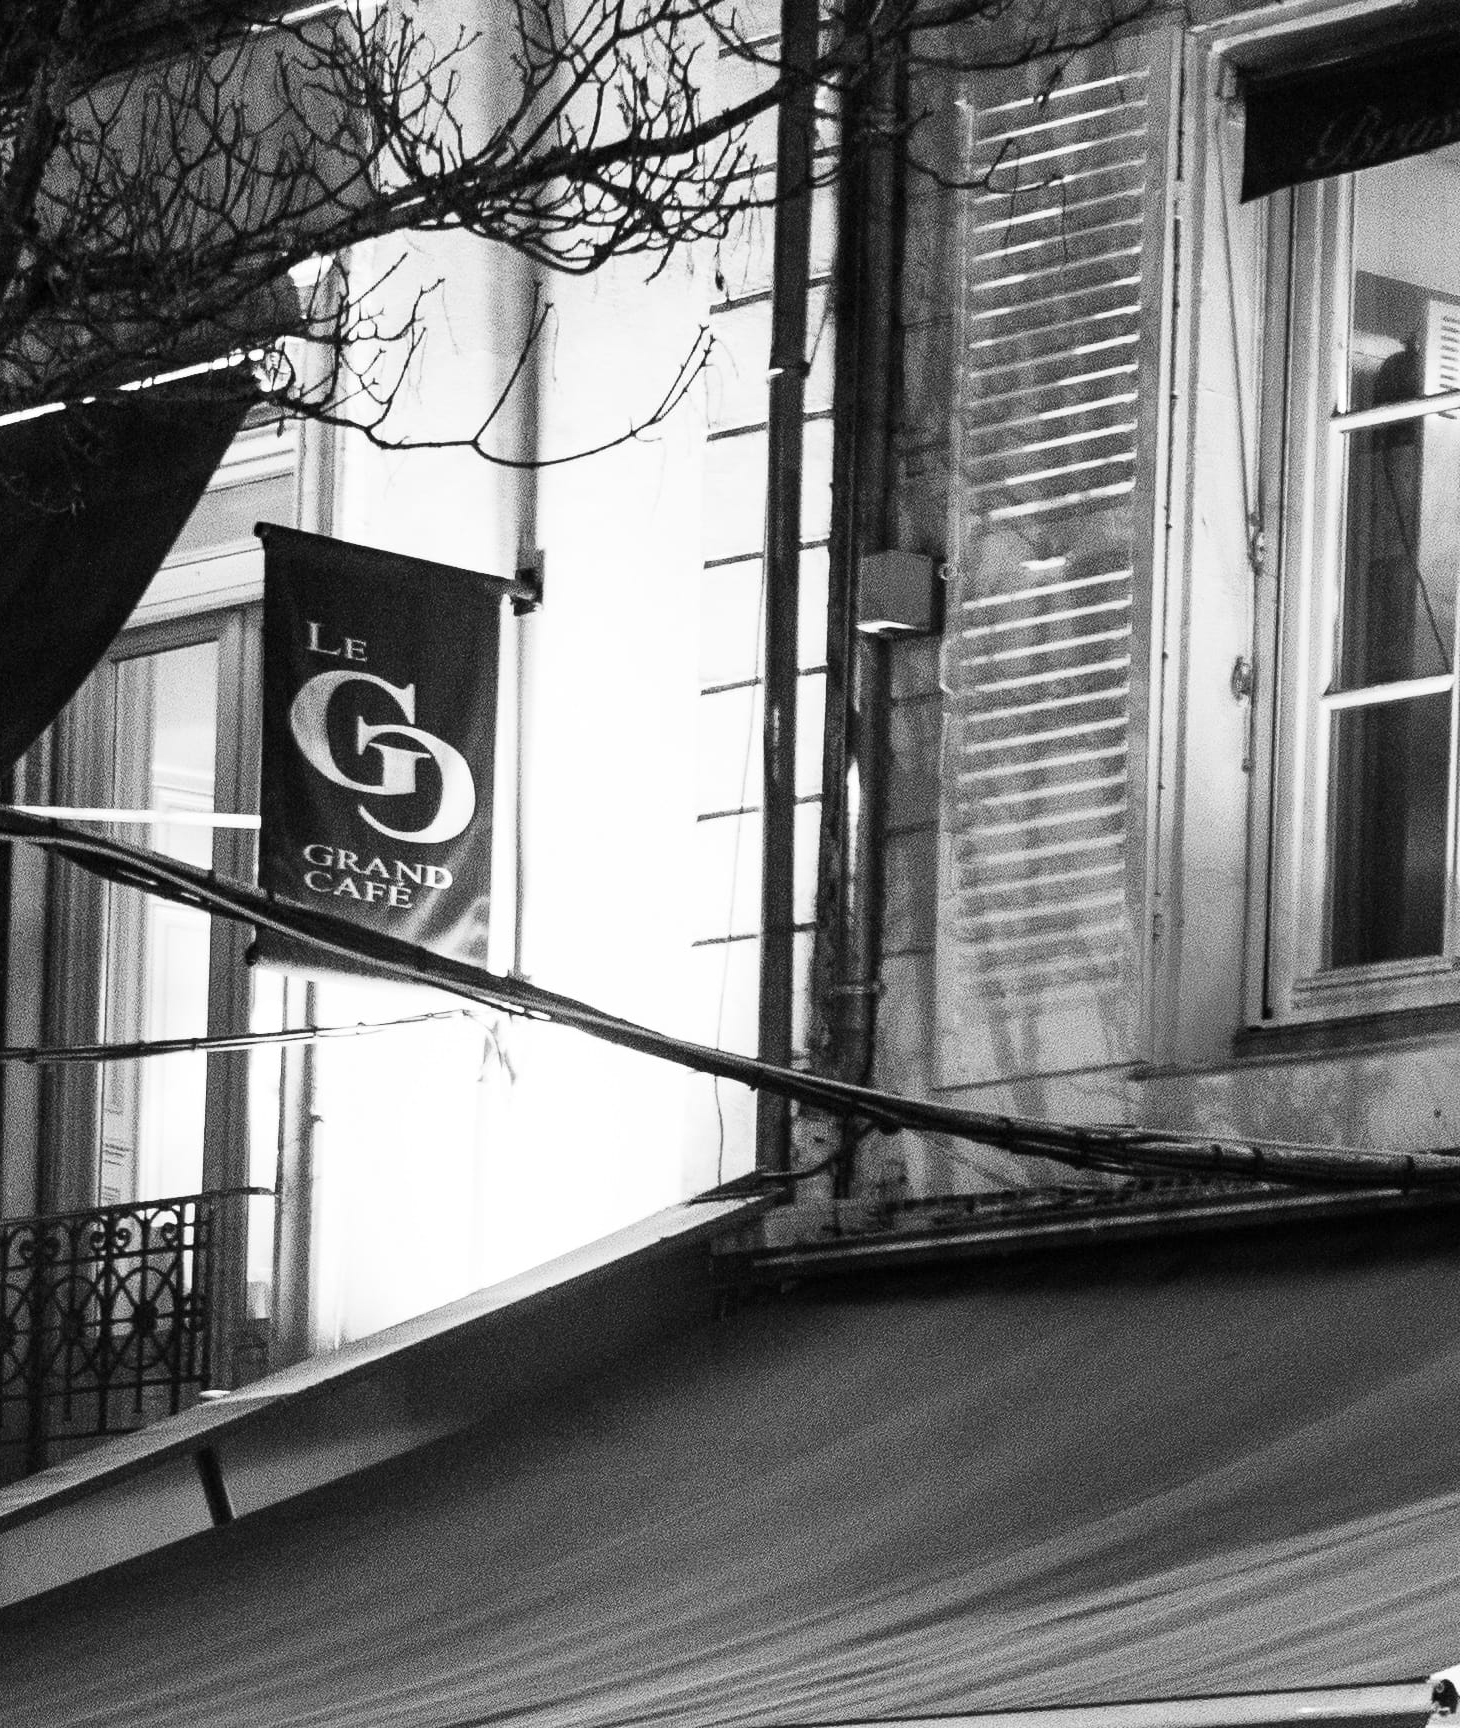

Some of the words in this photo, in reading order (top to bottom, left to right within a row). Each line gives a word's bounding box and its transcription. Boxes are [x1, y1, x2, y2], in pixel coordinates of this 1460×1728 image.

[307, 621, 367, 662] LE
[302, 843, 454, 891] GRAND
[303, 870, 413, 909] CAFÉ
